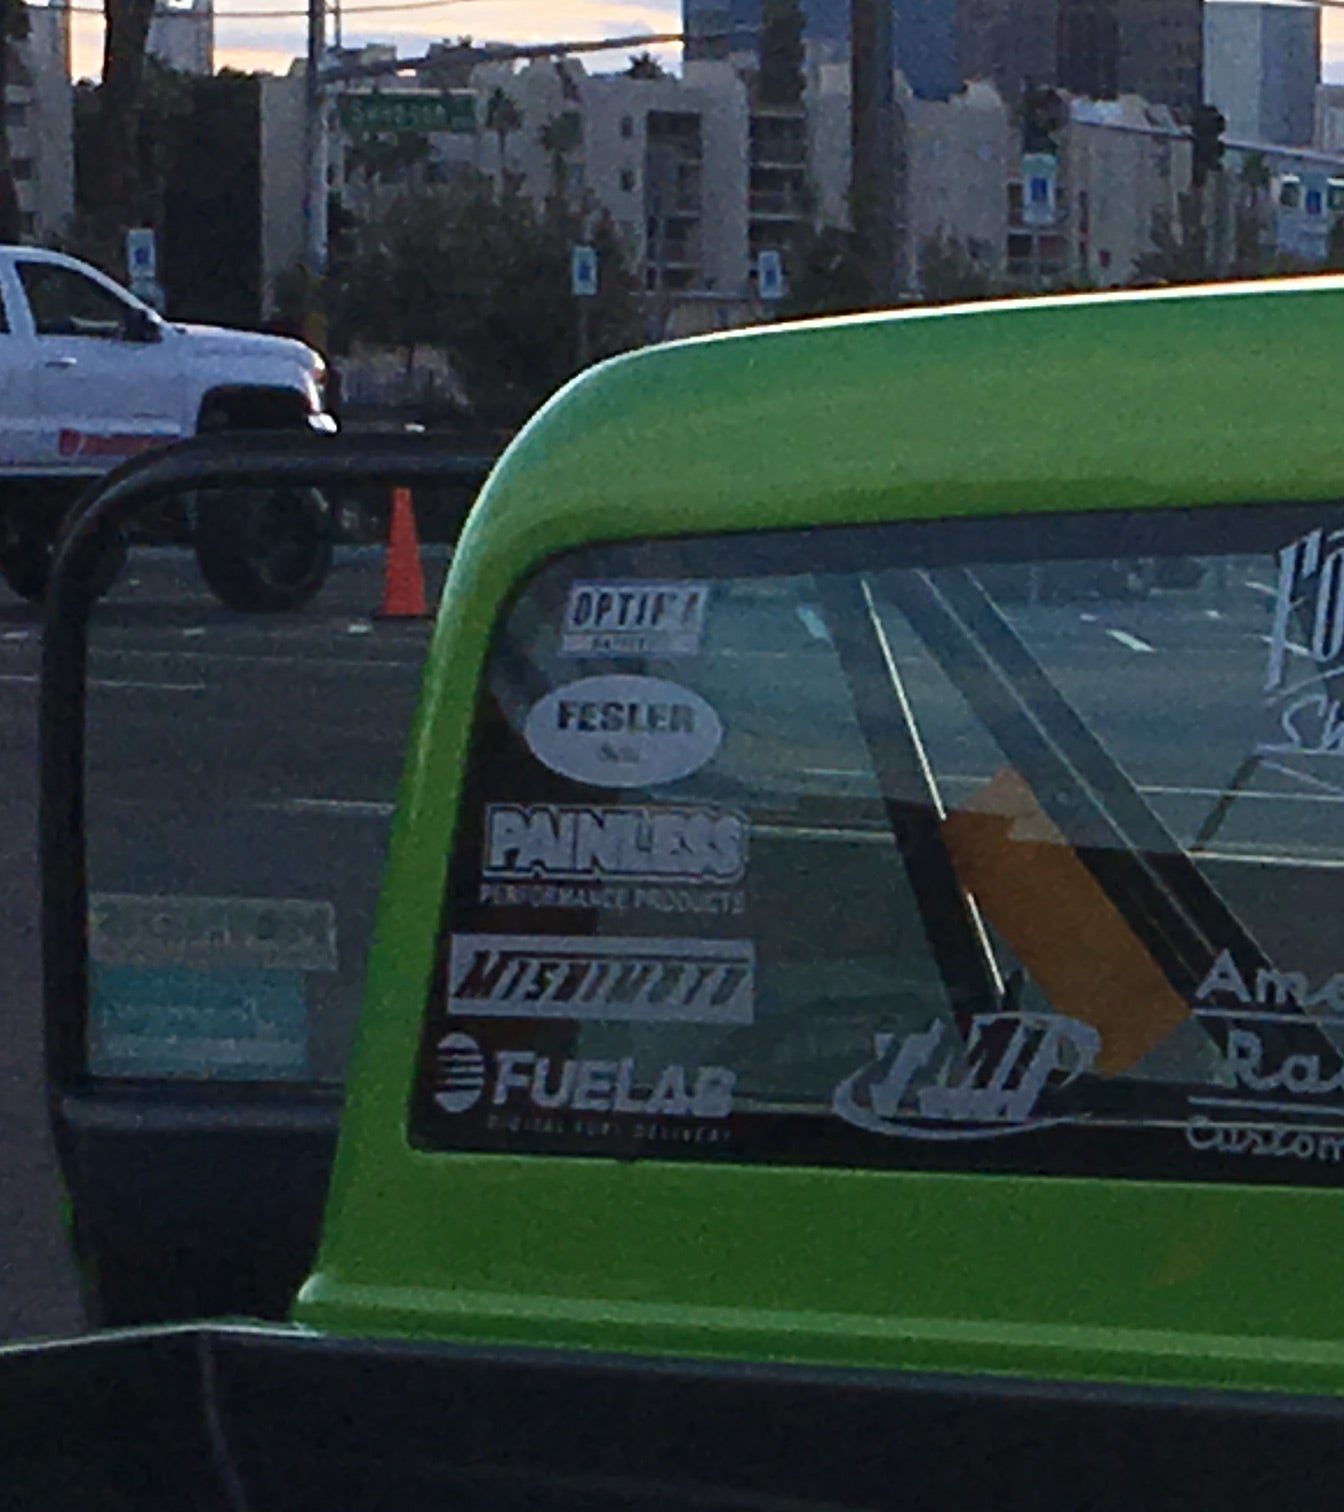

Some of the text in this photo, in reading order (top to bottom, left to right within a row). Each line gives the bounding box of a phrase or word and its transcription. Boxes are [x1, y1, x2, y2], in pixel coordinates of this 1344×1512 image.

[557, 701, 695, 733] FESLER
[483, 805, 749, 883] PAINLESS
[493, 1051, 737, 1118] FUELAB
